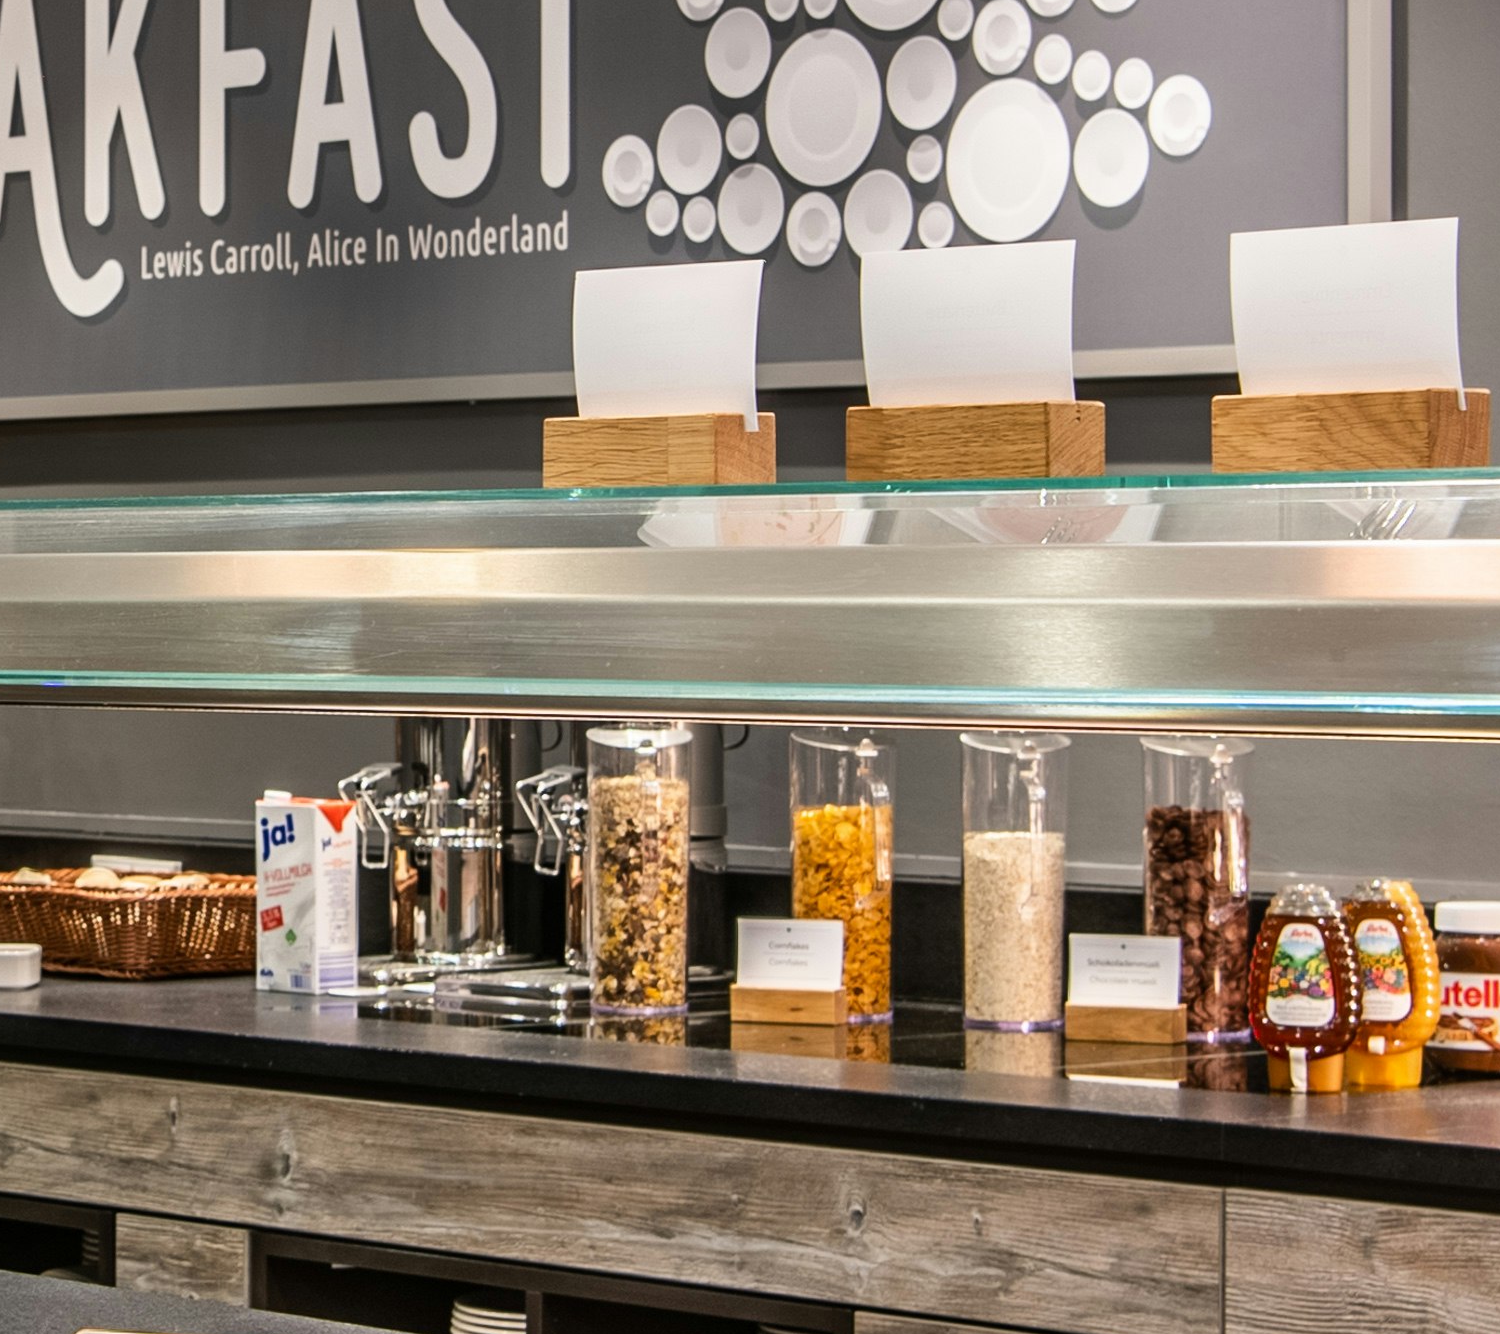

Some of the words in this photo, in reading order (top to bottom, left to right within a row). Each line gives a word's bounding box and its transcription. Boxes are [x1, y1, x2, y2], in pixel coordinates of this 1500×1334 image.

[140, 240, 204, 281] Lewis
[210, 231, 300, 277] Carroll,
[307, 228, 368, 268] Alice
[376, 228, 399, 266] In
[408, 209, 570, 262] Wonderland
[260, 813, 296, 862] ja!
